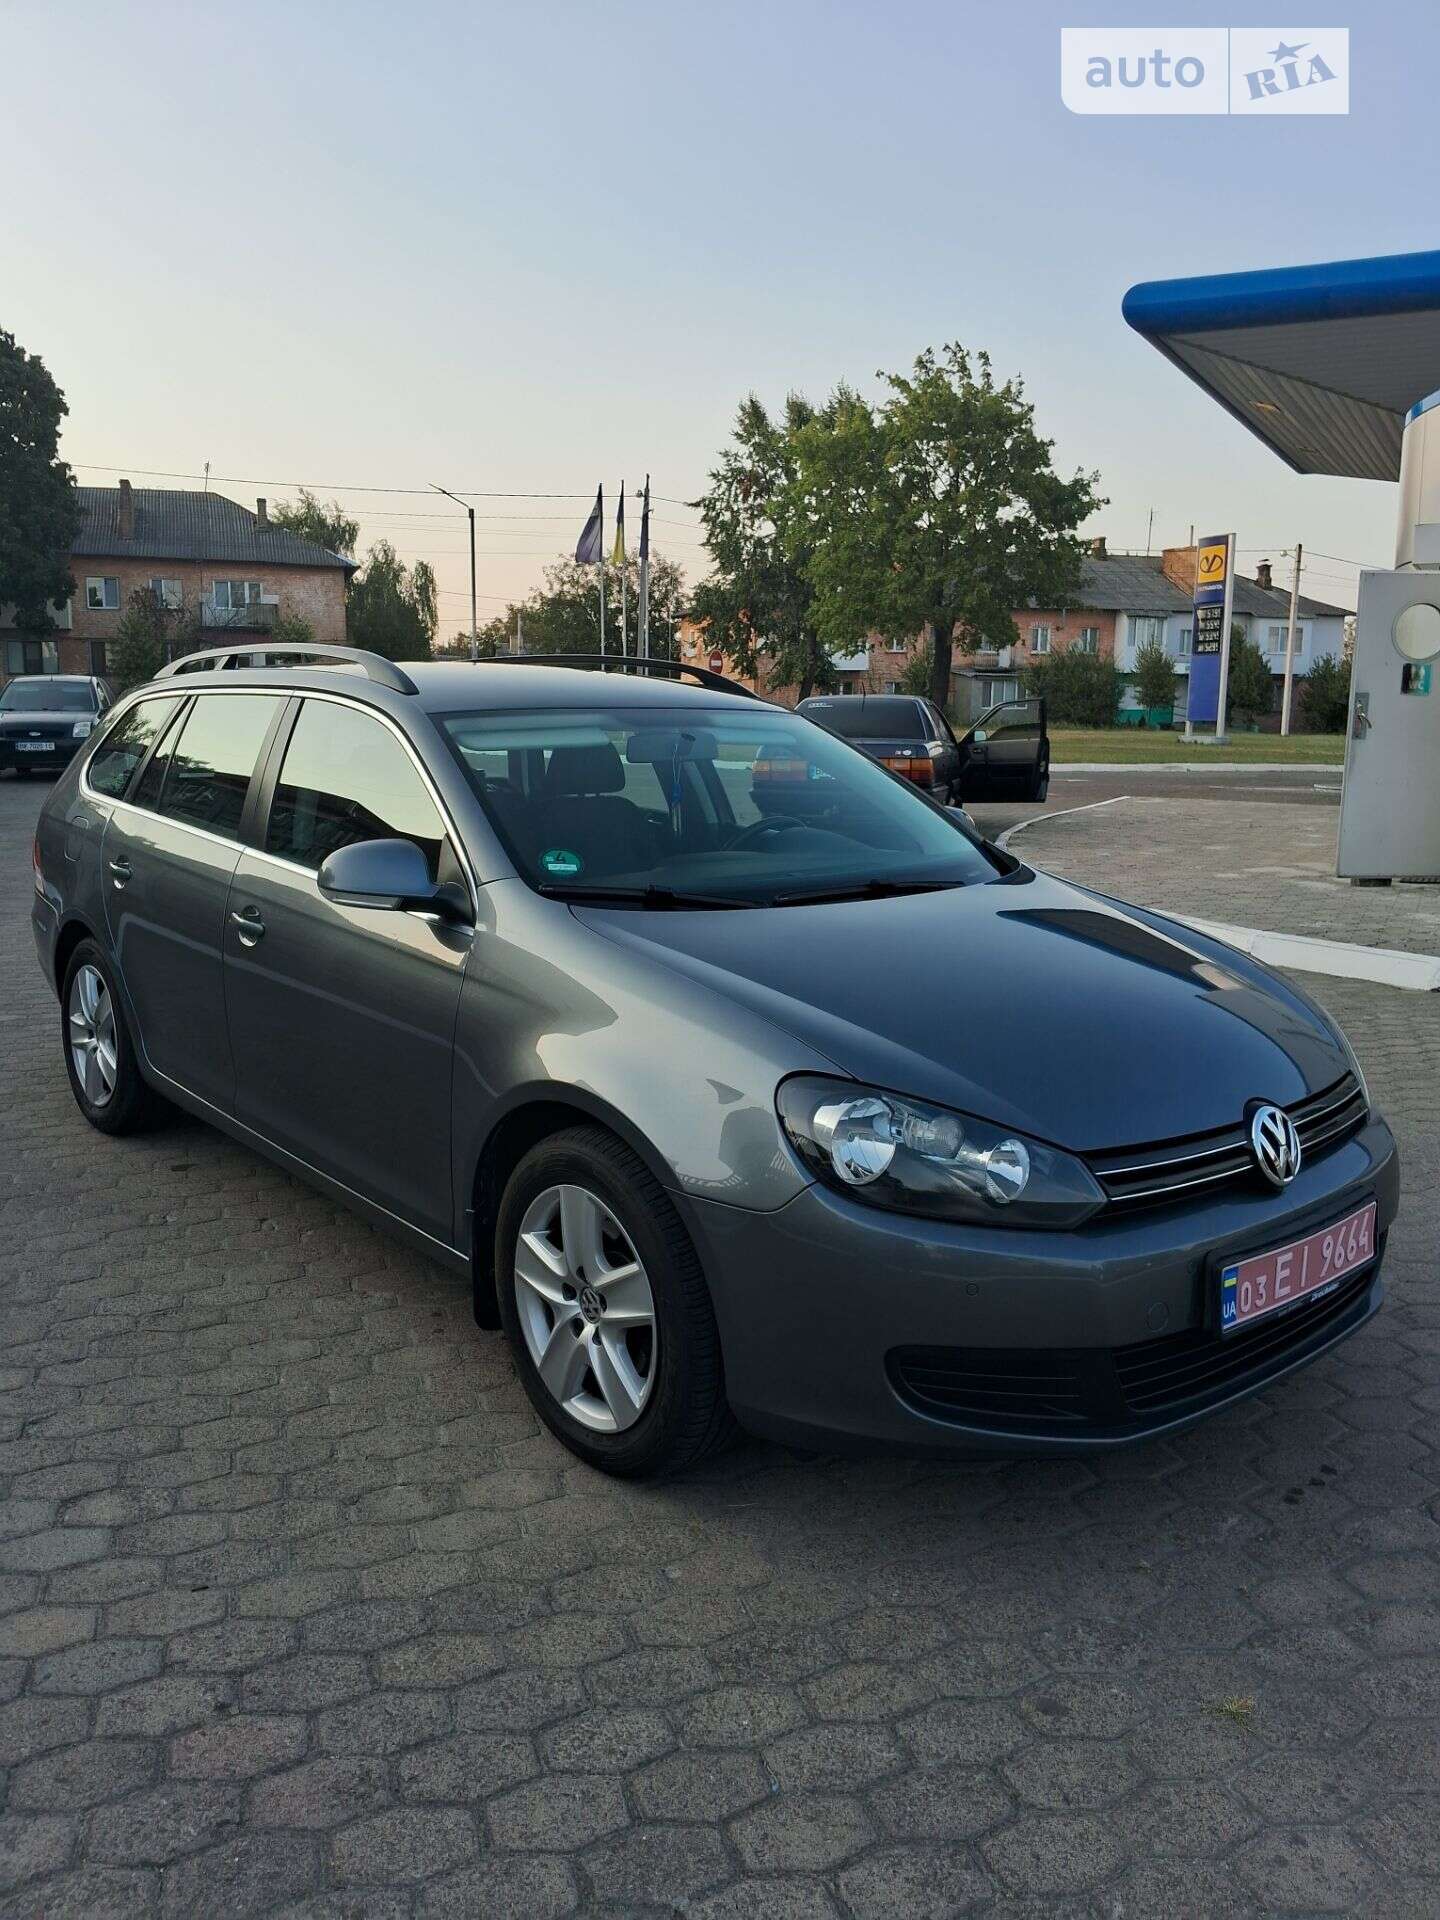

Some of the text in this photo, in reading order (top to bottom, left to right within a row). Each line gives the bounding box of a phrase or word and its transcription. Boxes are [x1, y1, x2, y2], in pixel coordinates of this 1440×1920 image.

[1240, 1213, 1369, 1313] 03 EI 9664
[1223, 1302, 1236, 1318] UA
